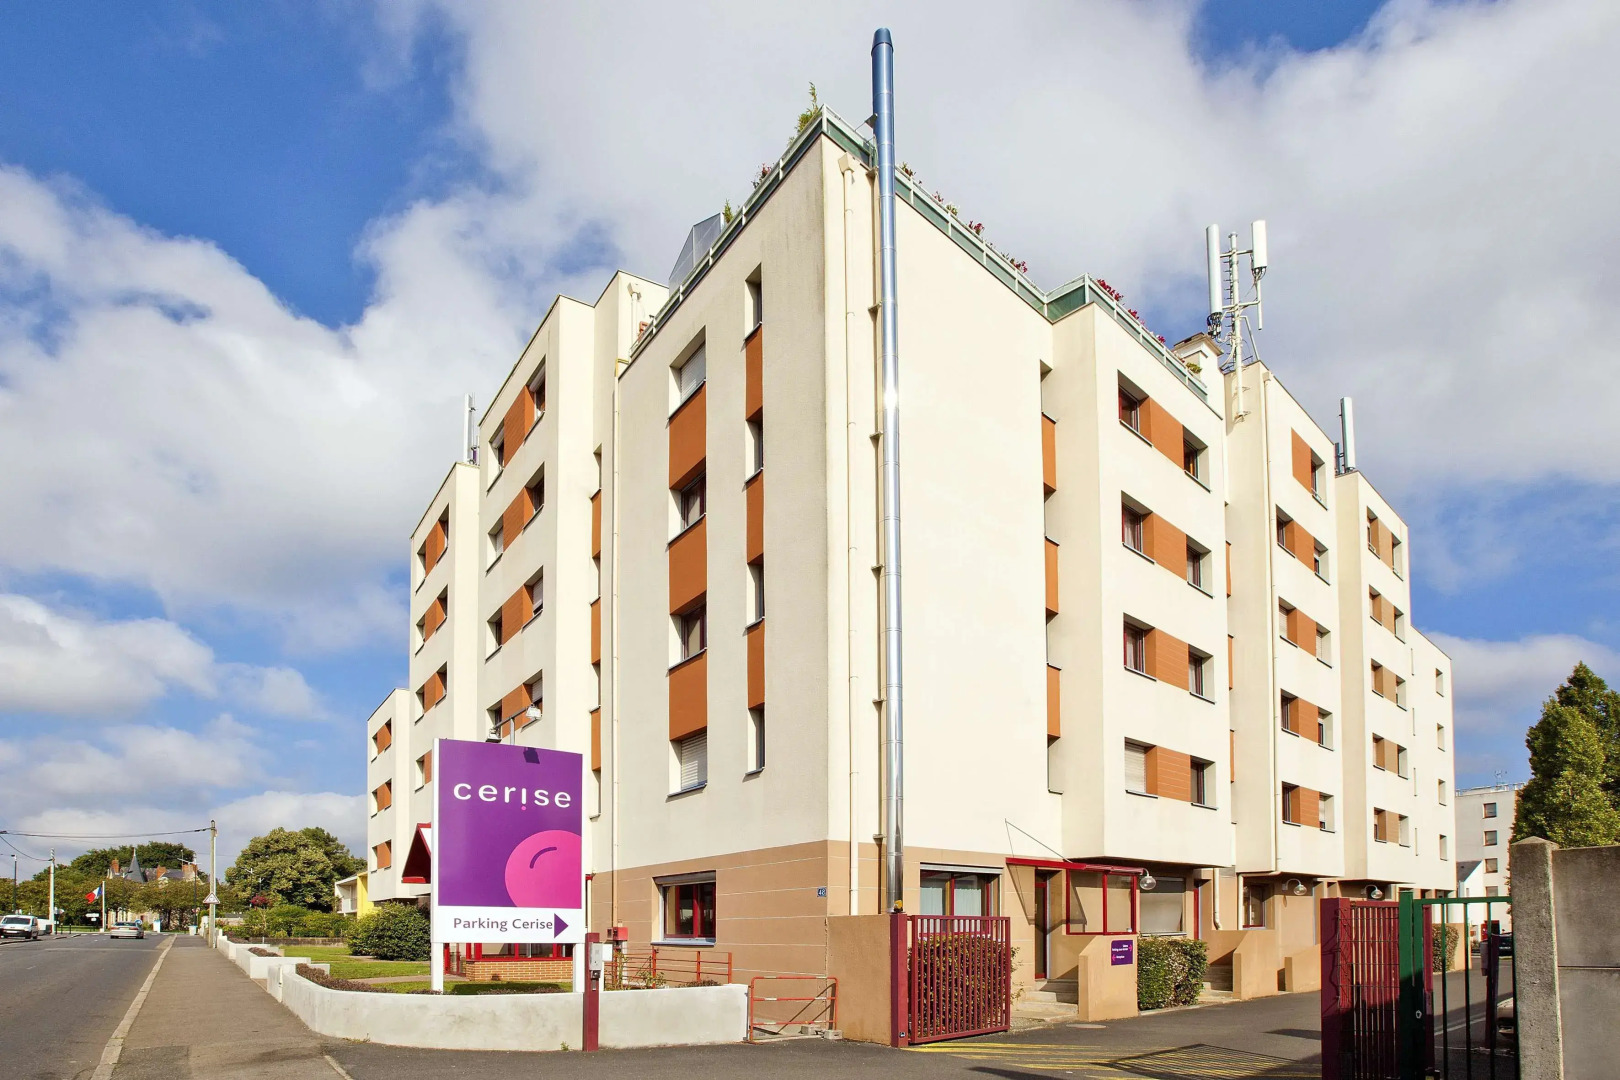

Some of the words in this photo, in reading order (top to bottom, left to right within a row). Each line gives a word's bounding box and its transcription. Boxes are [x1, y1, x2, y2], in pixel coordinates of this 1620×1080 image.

[453, 783, 571, 811] cerise
[453, 917, 508, 932] Parking
[512, 918, 553, 930] Cerise
